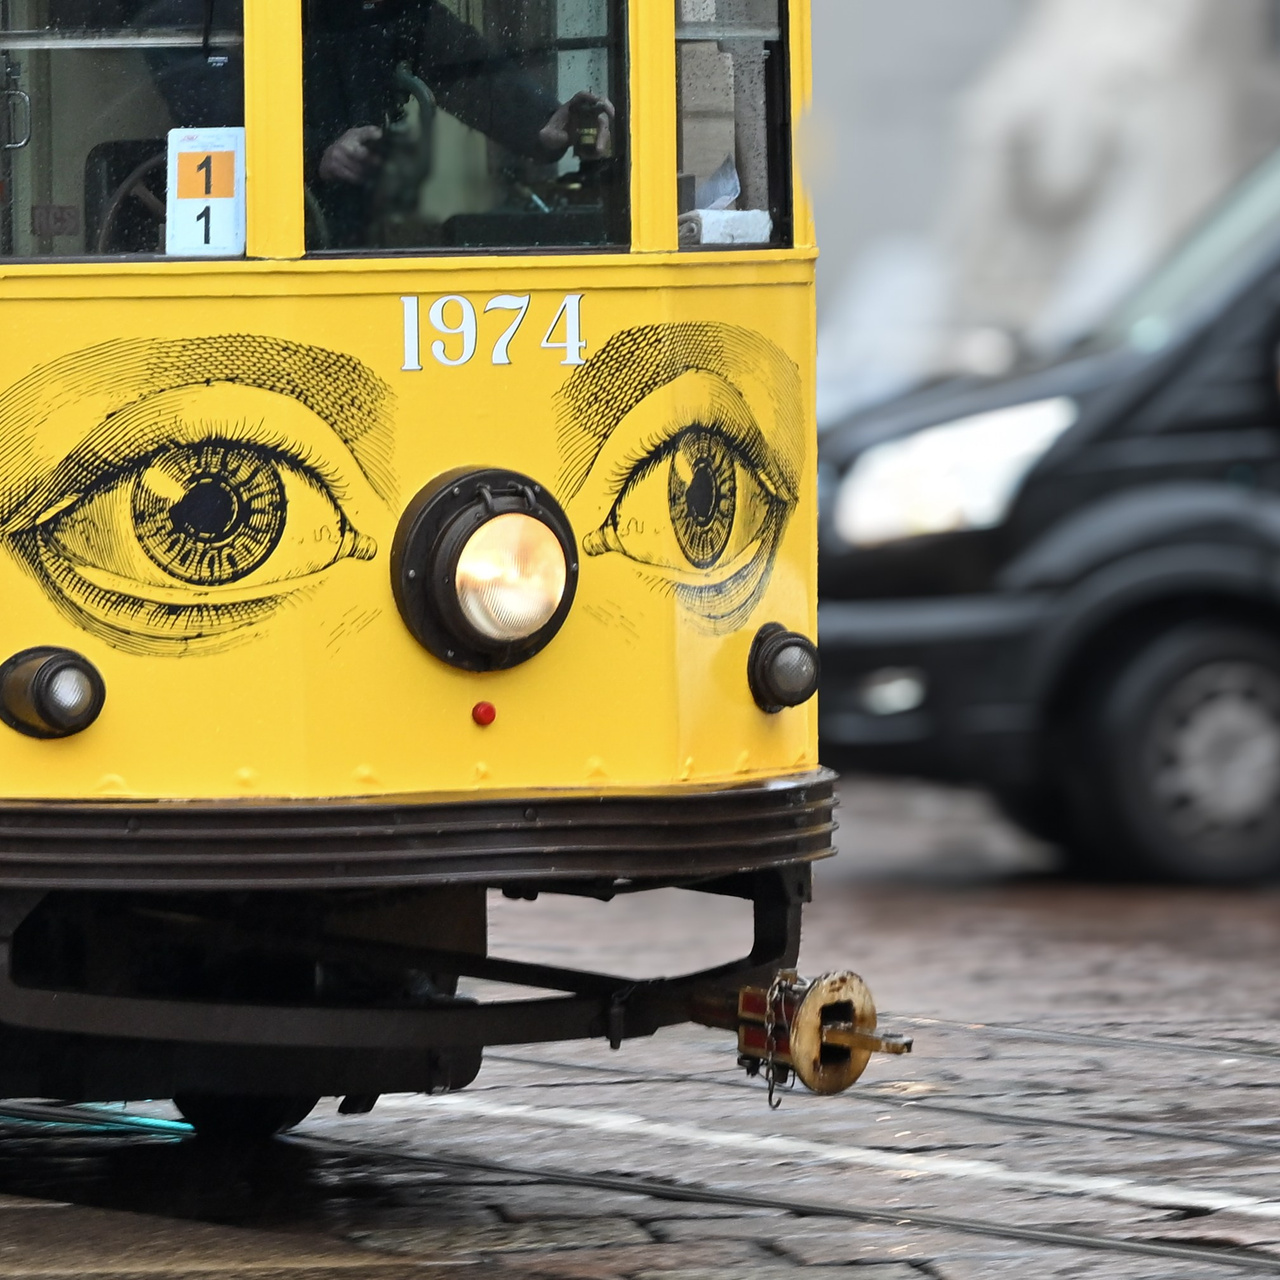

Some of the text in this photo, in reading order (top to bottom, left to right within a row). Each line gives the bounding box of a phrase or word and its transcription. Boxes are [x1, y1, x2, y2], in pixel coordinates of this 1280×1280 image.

[196, 154, 213, 196] 1
[195, 205, 211, 245] 1
[400, 293, 588, 371] 1974
